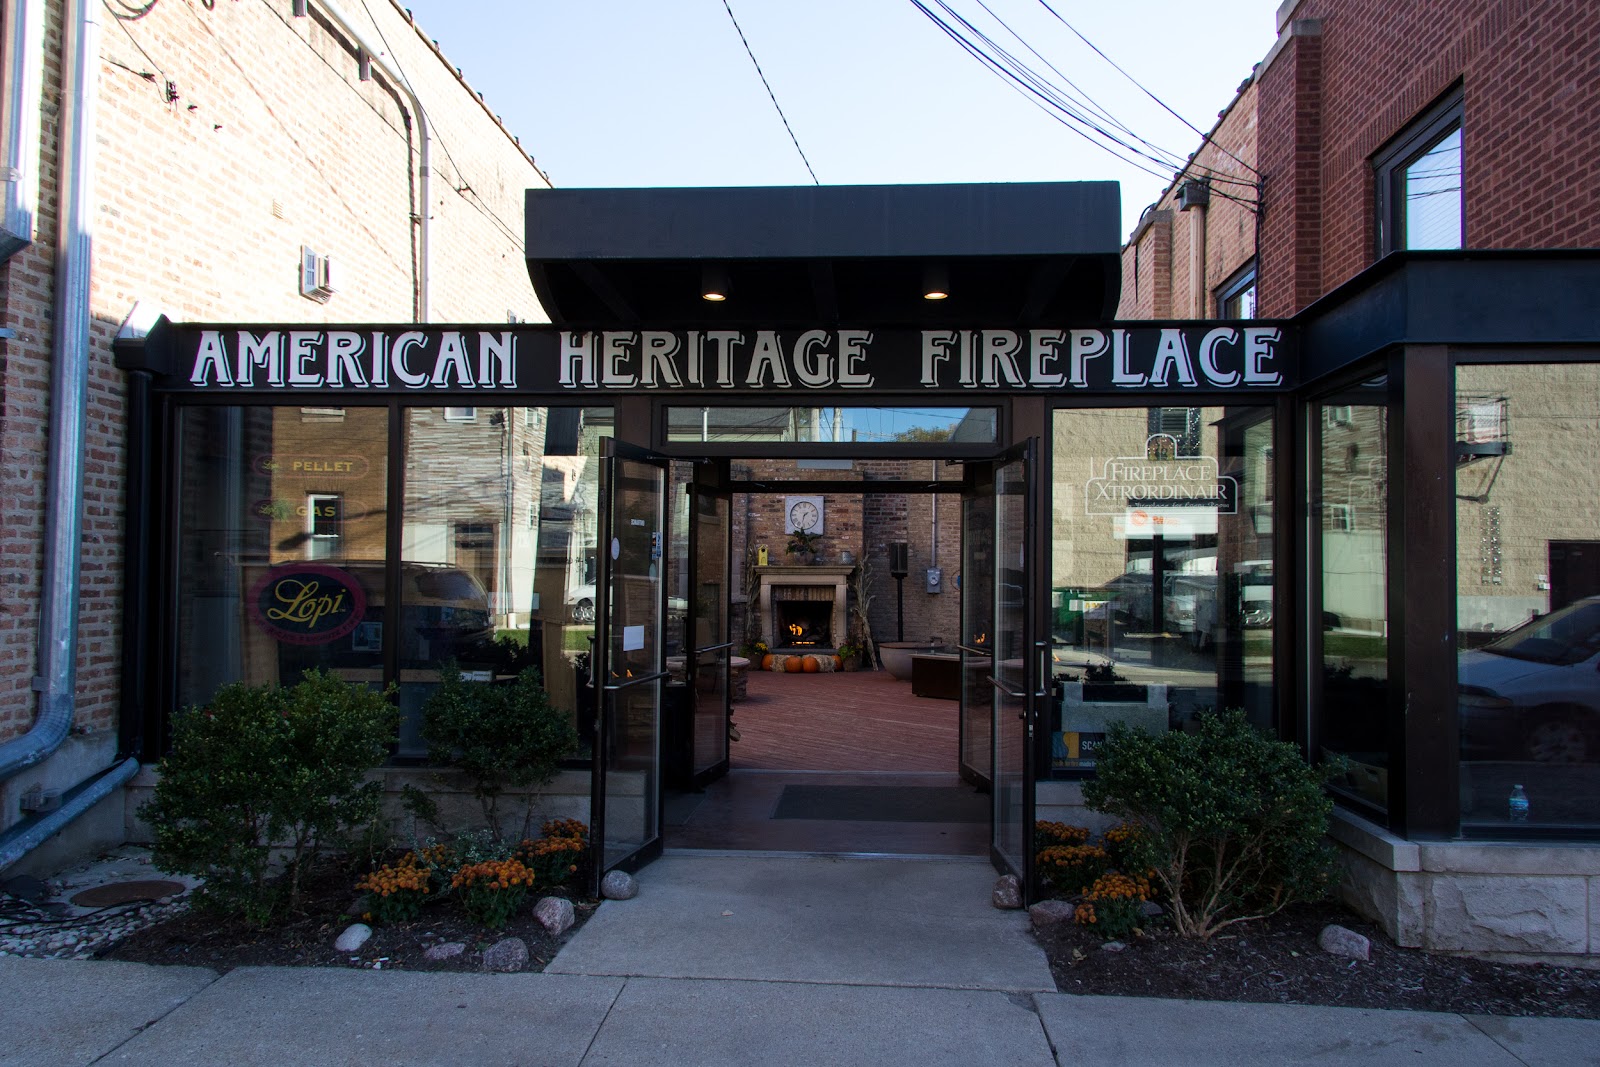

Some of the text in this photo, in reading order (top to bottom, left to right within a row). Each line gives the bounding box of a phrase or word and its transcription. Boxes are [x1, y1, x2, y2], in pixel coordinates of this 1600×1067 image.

[190, 327, 1283, 389] AMERICAN HERITAGE FIREPLACE
[293, 461, 353, 472] PELLET
[1111, 462, 1211, 481] FIREPLACE
[1095, 482, 1228, 501] XTRORDINAIR
[296, 506, 336, 517] GAS
[267, 579, 347, 628] Lopi
